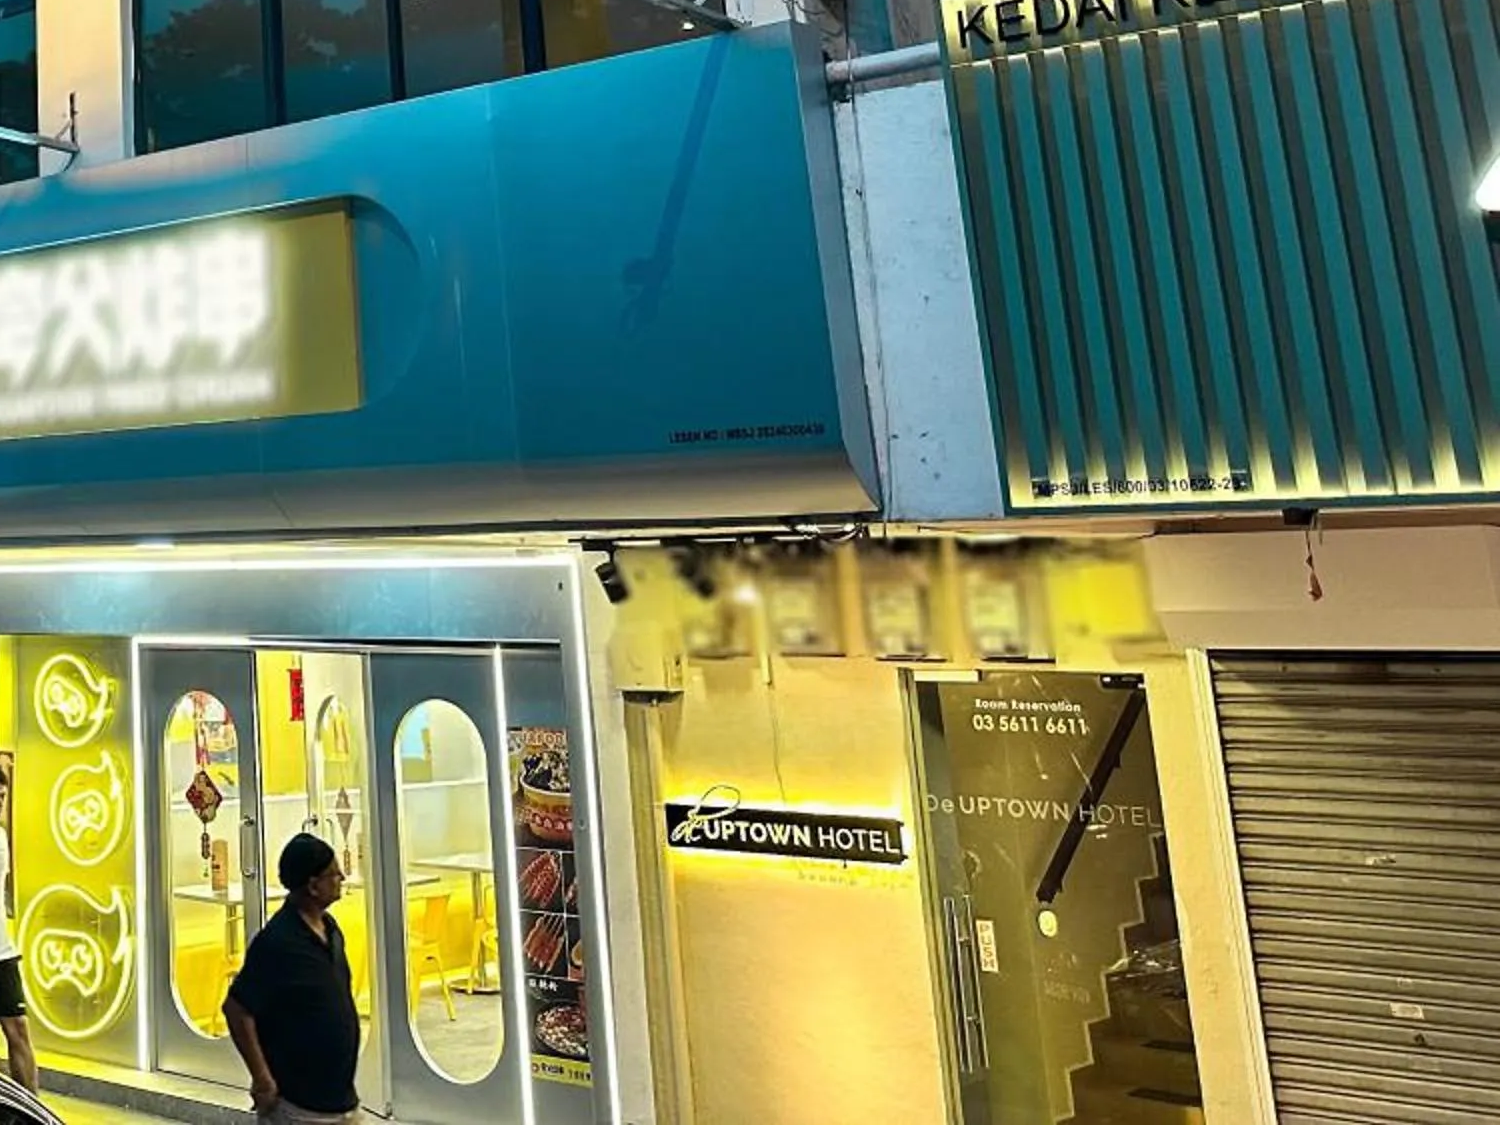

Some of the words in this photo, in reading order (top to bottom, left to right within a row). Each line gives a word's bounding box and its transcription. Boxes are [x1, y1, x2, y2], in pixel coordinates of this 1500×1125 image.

[975, 698, 1008, 711] Room
[1011, 699, 1081, 713] Reservation
[973, 714, 995, 731] 03
[999, 715, 1038, 733] 5611
[1045, 718, 1088, 736] 6611
[958, 795, 1070, 821] UPTOWN
[1078, 803, 1163, 829] HOTEL
[703, 820, 812, 847] UPTOWN
[817, 826, 901, 854] HOTEL
[978, 922, 996, 970] PUSH
